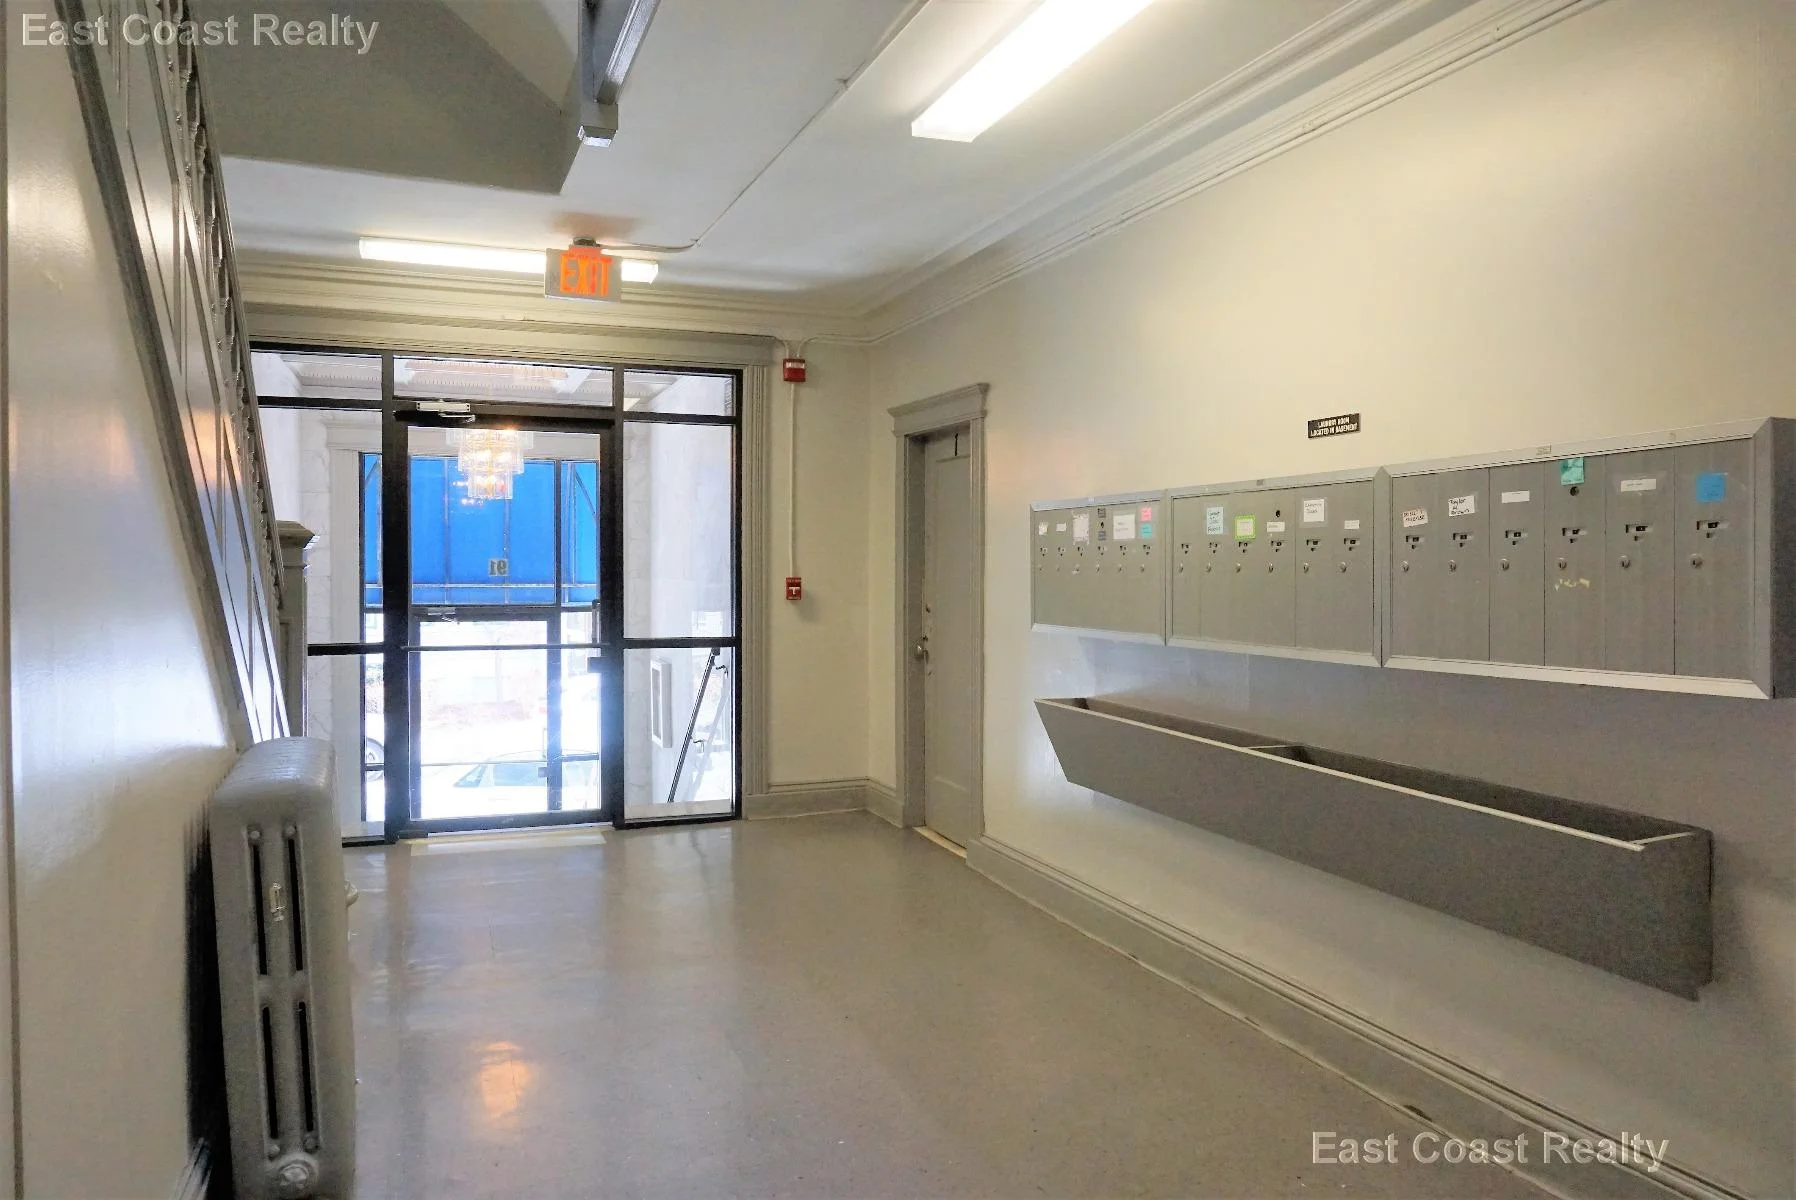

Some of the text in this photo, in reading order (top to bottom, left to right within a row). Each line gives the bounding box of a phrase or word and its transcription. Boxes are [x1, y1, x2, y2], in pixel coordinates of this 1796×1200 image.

[560, 253, 612, 297] EXIT
[1337, 416, 1350, 425] ROOM
[1310, 427, 1329, 436] LOCATED
[1336, 422, 1358, 433] BASEMENT
